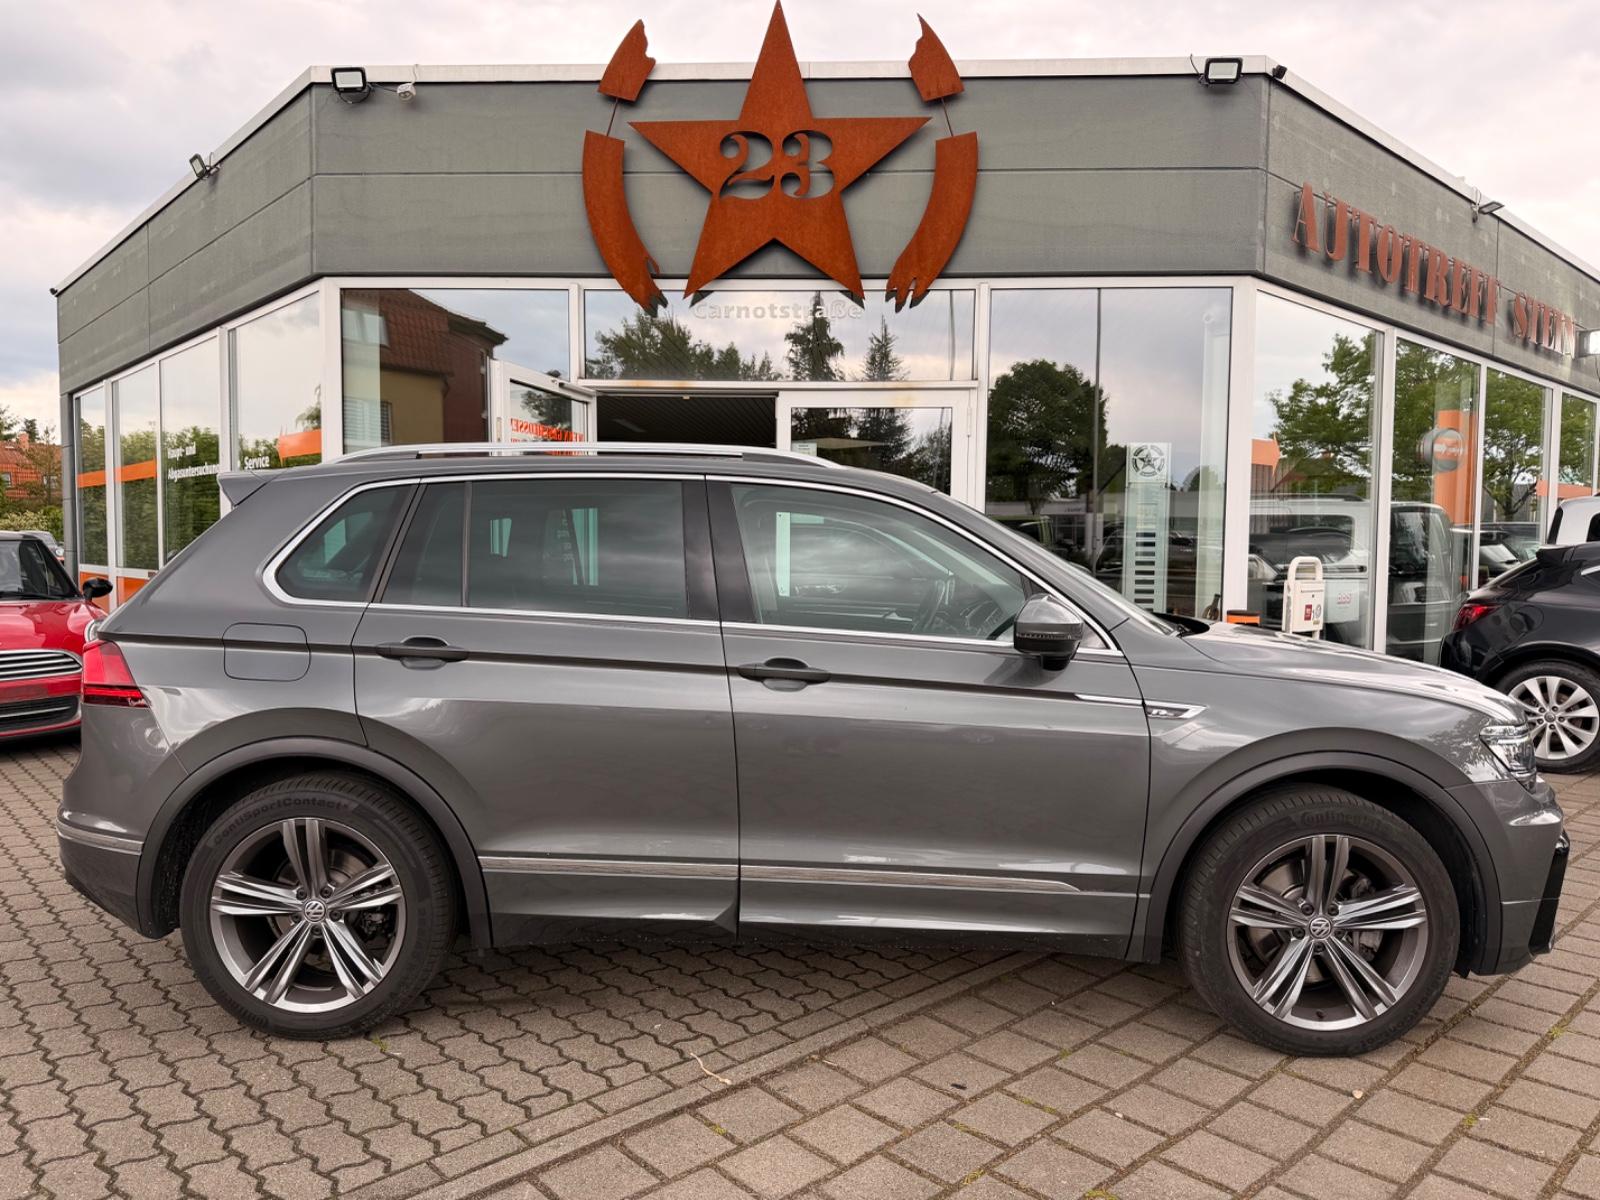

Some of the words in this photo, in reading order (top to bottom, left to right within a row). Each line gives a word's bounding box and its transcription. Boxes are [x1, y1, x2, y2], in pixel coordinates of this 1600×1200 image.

[719, 129, 835, 200] 23
[1290, 181, 1500, 325] AUTOTREFF
[694, 300, 863, 320] Carnotstraße
[244, 454, 270, 470] Service
